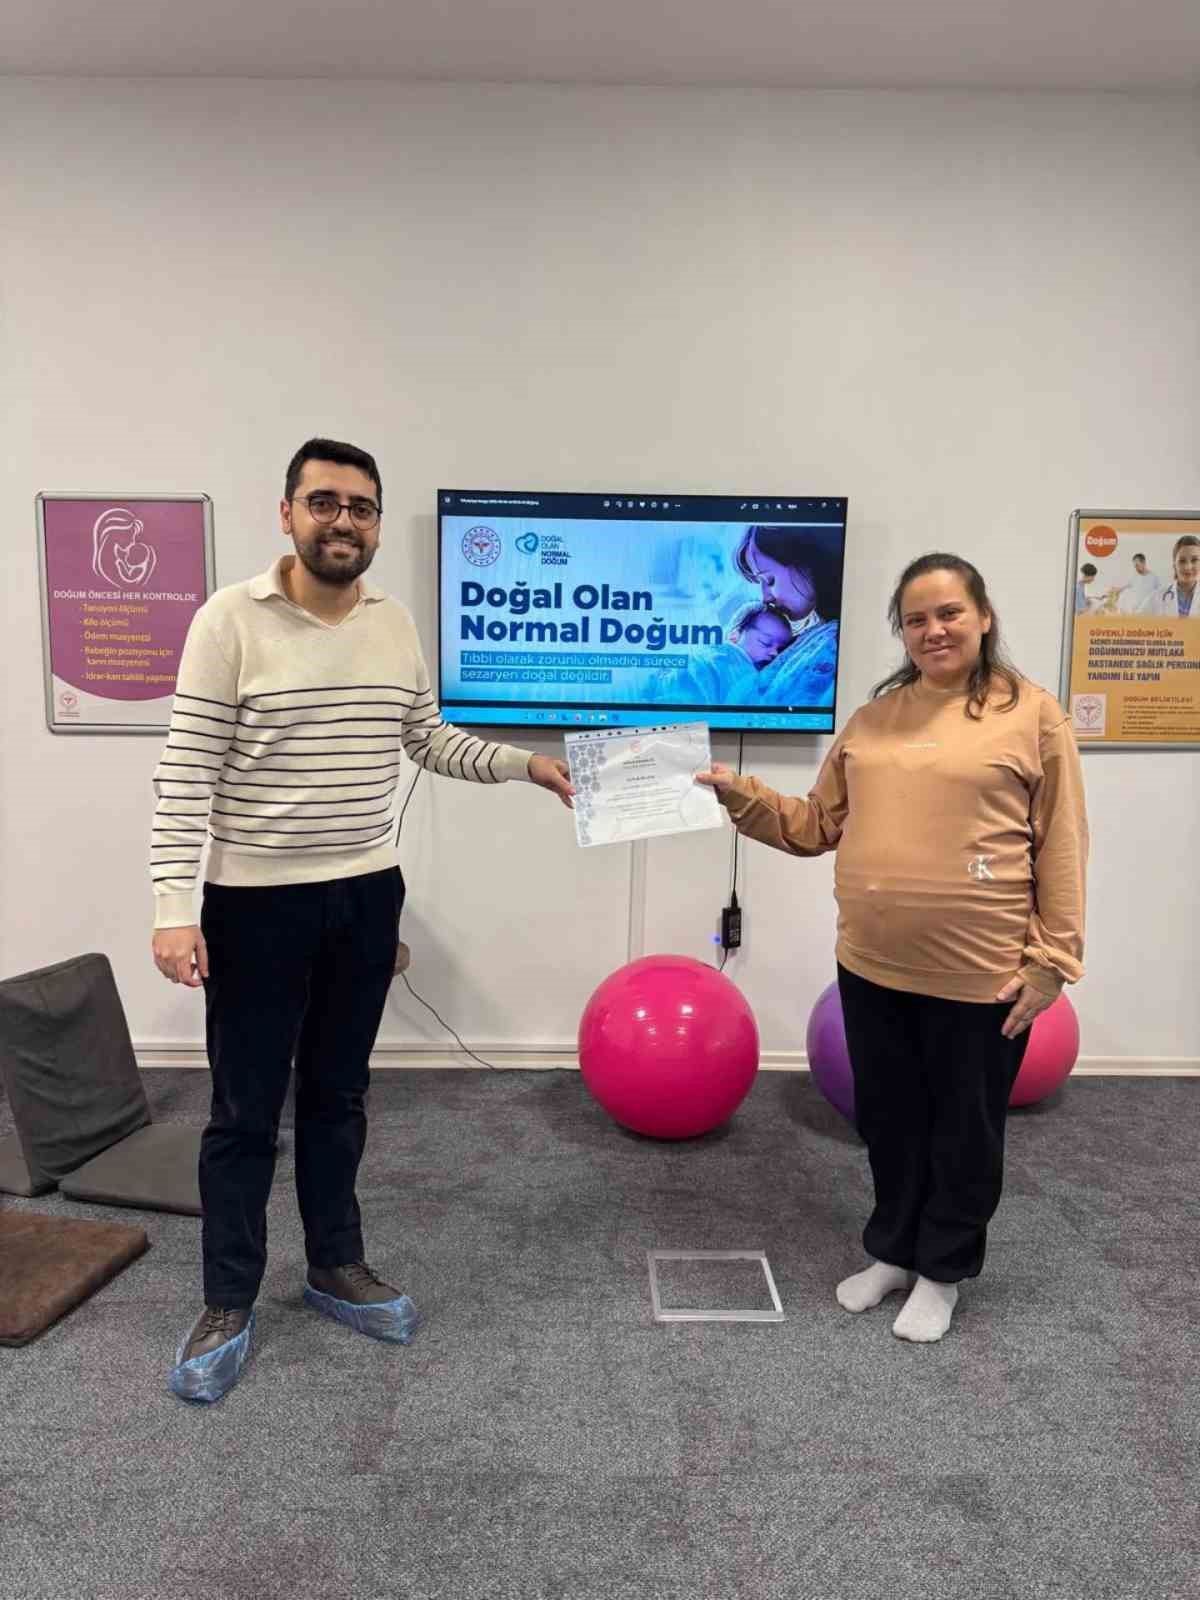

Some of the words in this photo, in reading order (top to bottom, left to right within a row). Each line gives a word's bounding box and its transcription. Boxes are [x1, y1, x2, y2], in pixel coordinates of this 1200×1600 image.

[53, 589, 86, 600] DOĞUM
[88, 589, 121, 600] ÖNCESİ
[122, 591, 141, 601] HER
[143, 592, 199, 602] KONTROLDE
[460, 580, 563, 615] Doğal
[572, 583, 653, 611] Olan
[460, 615, 590, 643] Normal
[600, 616, 724, 651] Doğum
[1147, 648, 1185, 657] MUTLAKA
[496, 653, 533, 665] olarak
[538, 654, 586, 666] zorunlu
[644, 655, 685, 667] sürece
[462, 671, 518, 681] sezaryen
[520, 669, 557, 682] doğal
